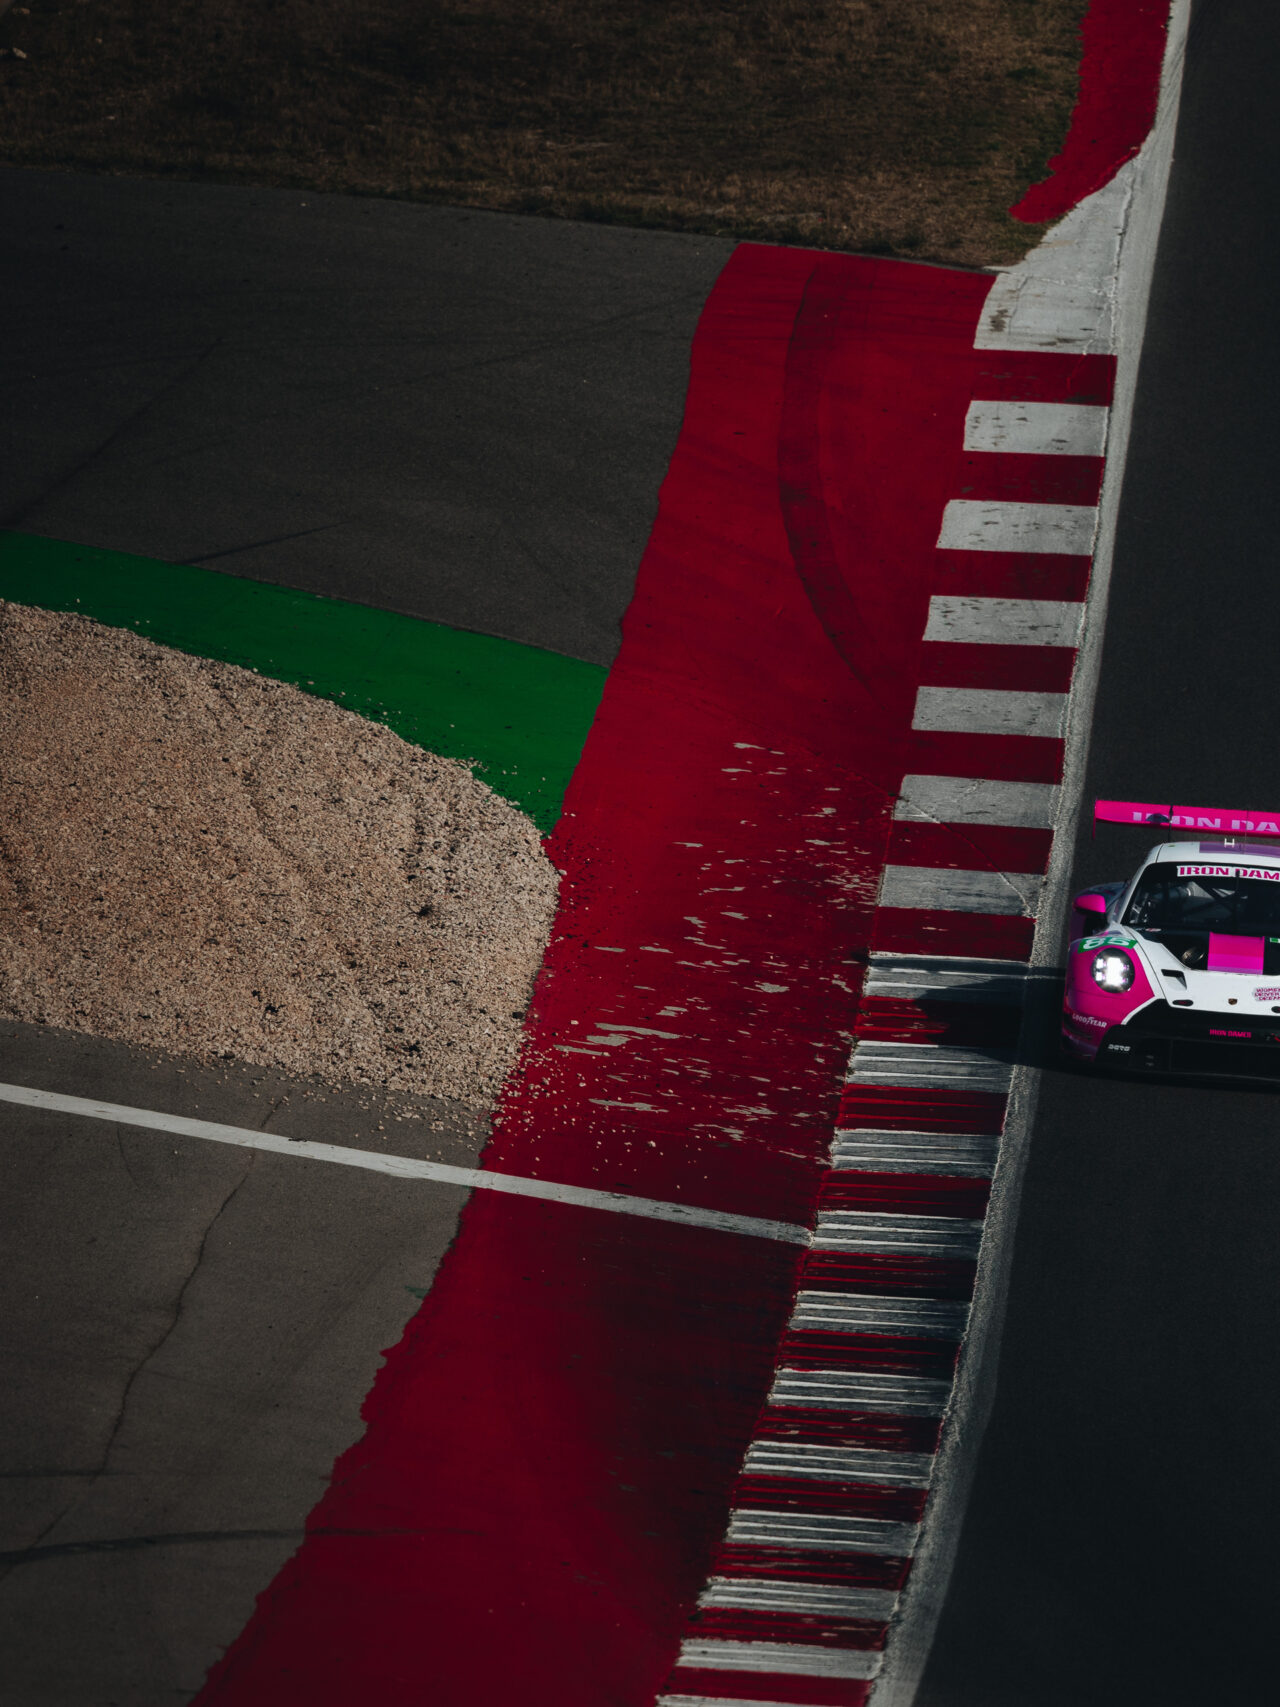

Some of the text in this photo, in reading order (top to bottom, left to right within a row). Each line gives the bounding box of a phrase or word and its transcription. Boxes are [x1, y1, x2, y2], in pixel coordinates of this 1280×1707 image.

[1132, 811, 1221, 828] ION
[1179, 866, 1229, 877] IRON
[1083, 937, 1130, 950] 85
[1072, 1012, 1108, 1029] GOODYEAR
[1209, 1028, 1252, 1039] IRON DAMES
